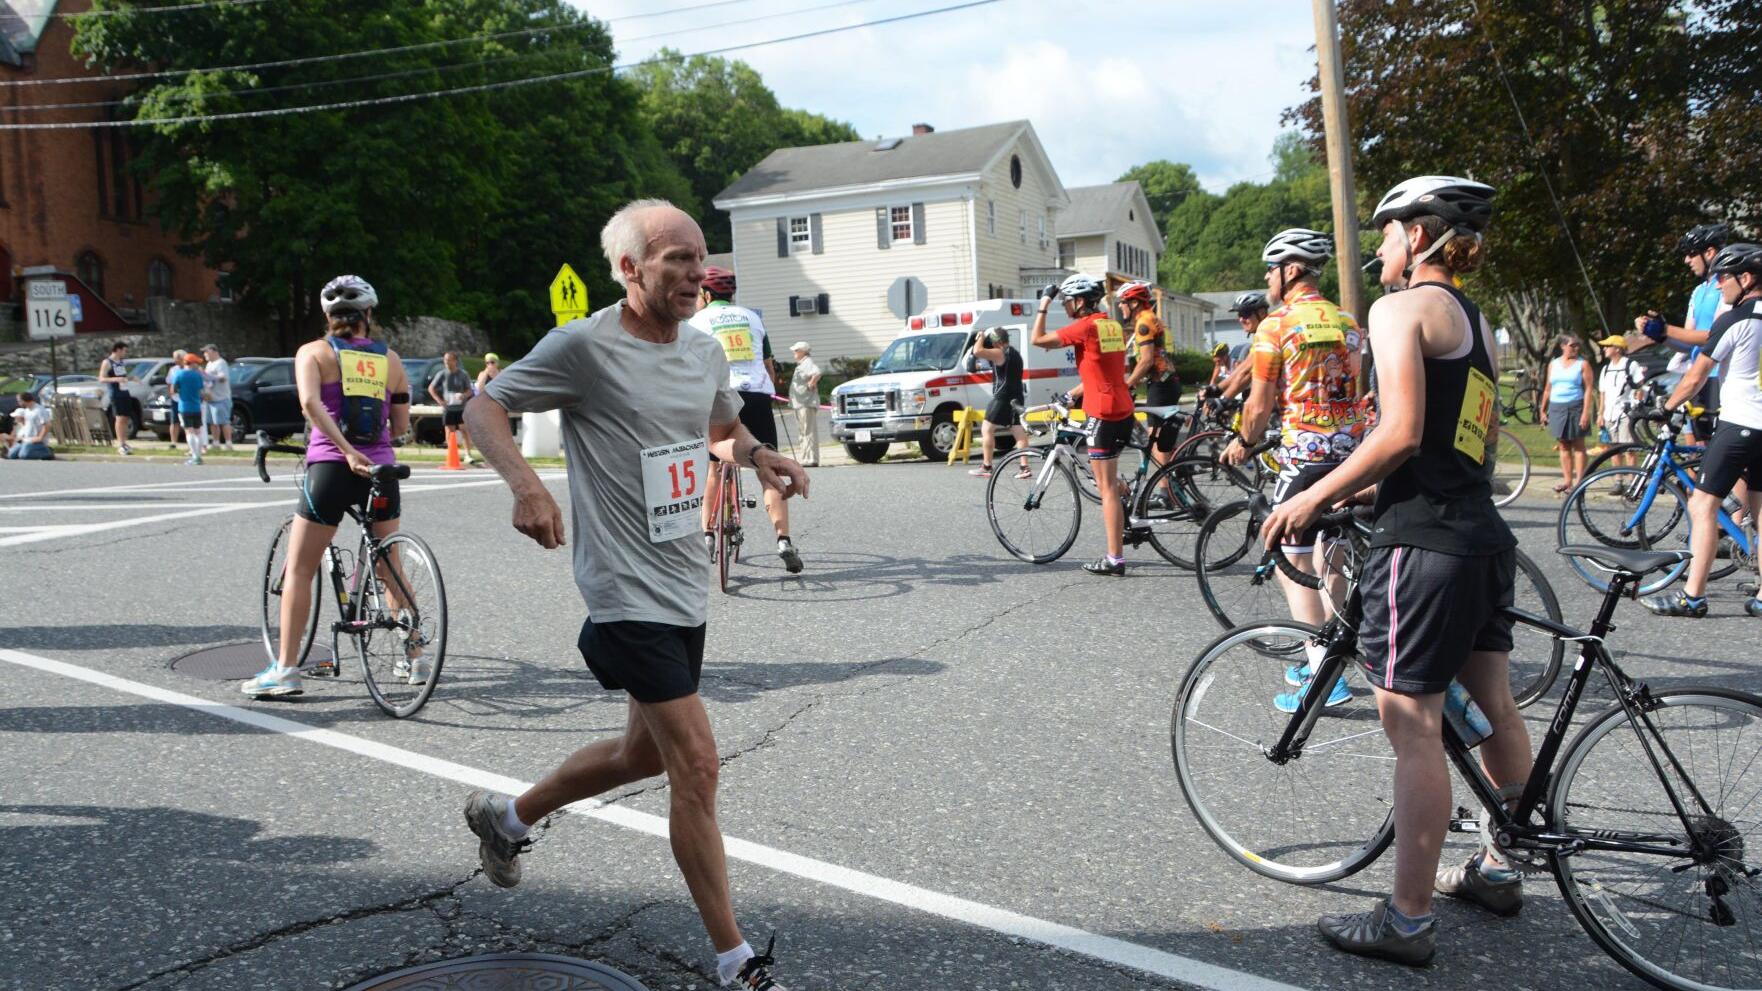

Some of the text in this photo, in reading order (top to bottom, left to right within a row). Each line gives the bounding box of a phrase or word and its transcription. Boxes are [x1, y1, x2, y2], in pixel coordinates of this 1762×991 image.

[33, 285, 64, 295] SOUTH
[35, 309, 66, 328] 116
[1316, 307, 1329, 322] 2
[1105, 324, 1116, 337] 12
[728, 334, 743, 348] 16
[357, 359, 376, 378] 45
[1476, 390, 1492, 428] 30
[668, 459, 695, 499] 15
[1553, 678, 1578, 735] COMP
